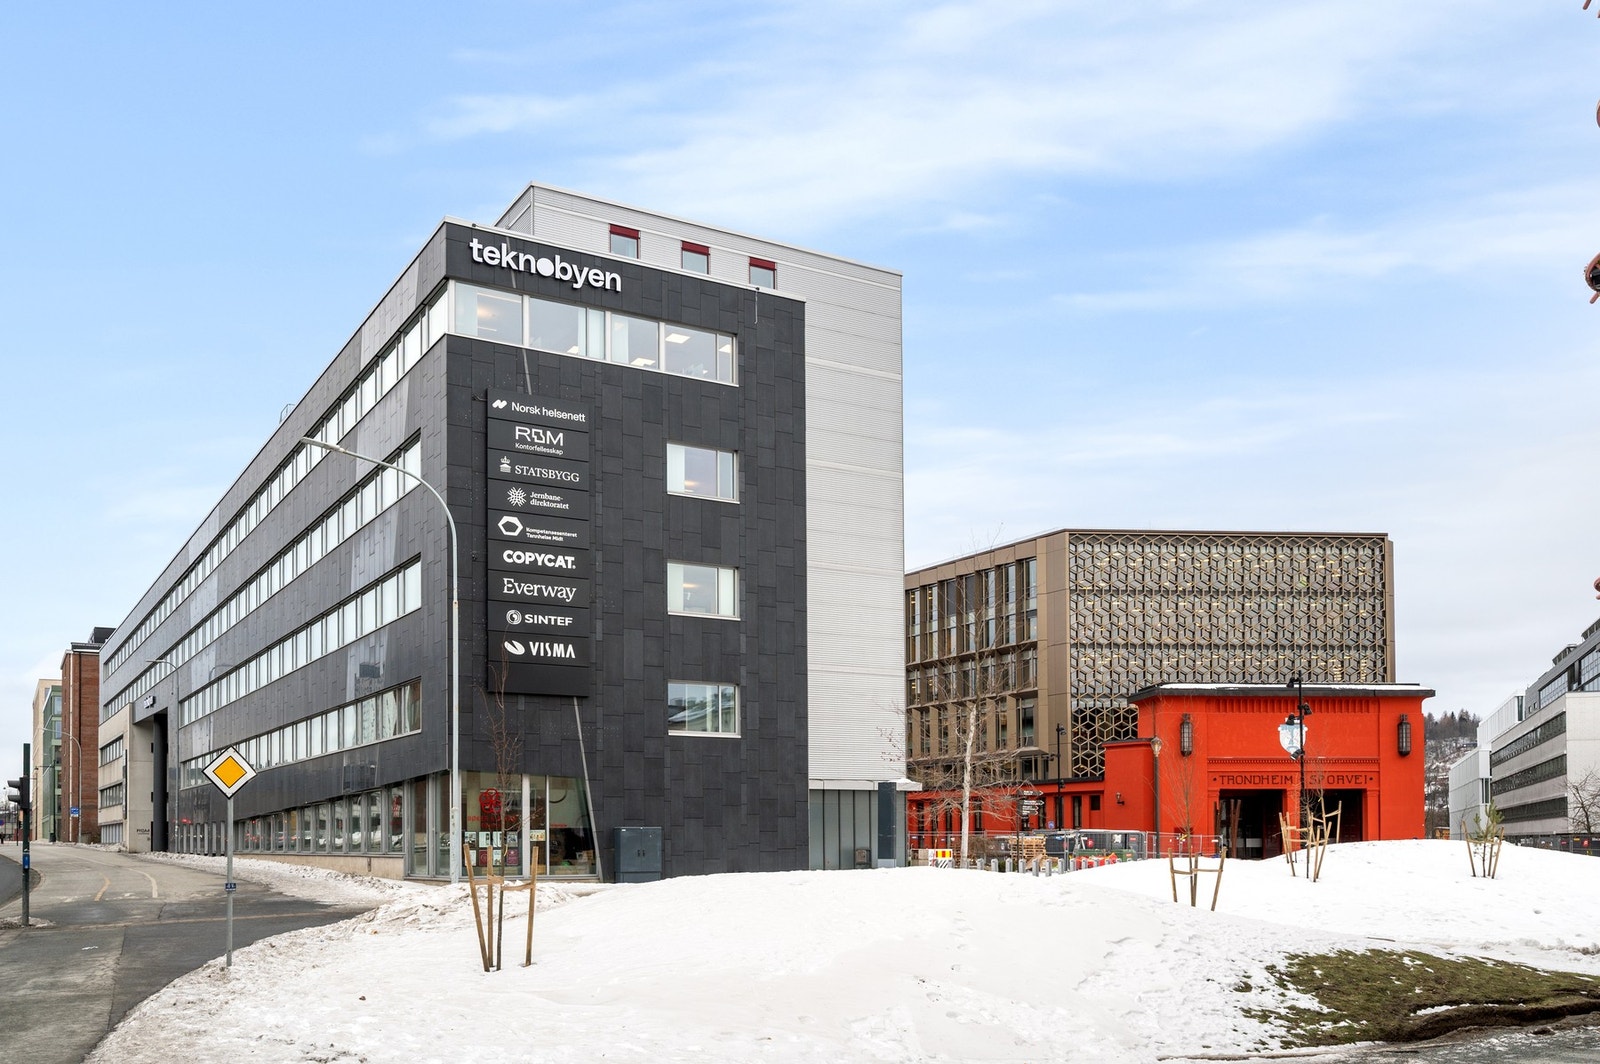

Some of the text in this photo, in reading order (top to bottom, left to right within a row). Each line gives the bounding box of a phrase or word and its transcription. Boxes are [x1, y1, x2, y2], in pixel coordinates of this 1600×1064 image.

[469, 238, 622, 292] teknobyen
[511, 401, 586, 422] Norsk helsenett
[515, 442, 564, 456] Kontorfellesskap
[514, 464, 580, 482] STATSBYGG
[529, 491, 564, 502] Jernbane-
[529, 498, 570, 510] direktoratet
[502, 577, 577, 603] Everway
[524, 613, 573, 627] SINTEF
[528, 641, 576, 660] VISMA
[1219, 773, 1368, 785] TRONDHEIM SPORVEI
